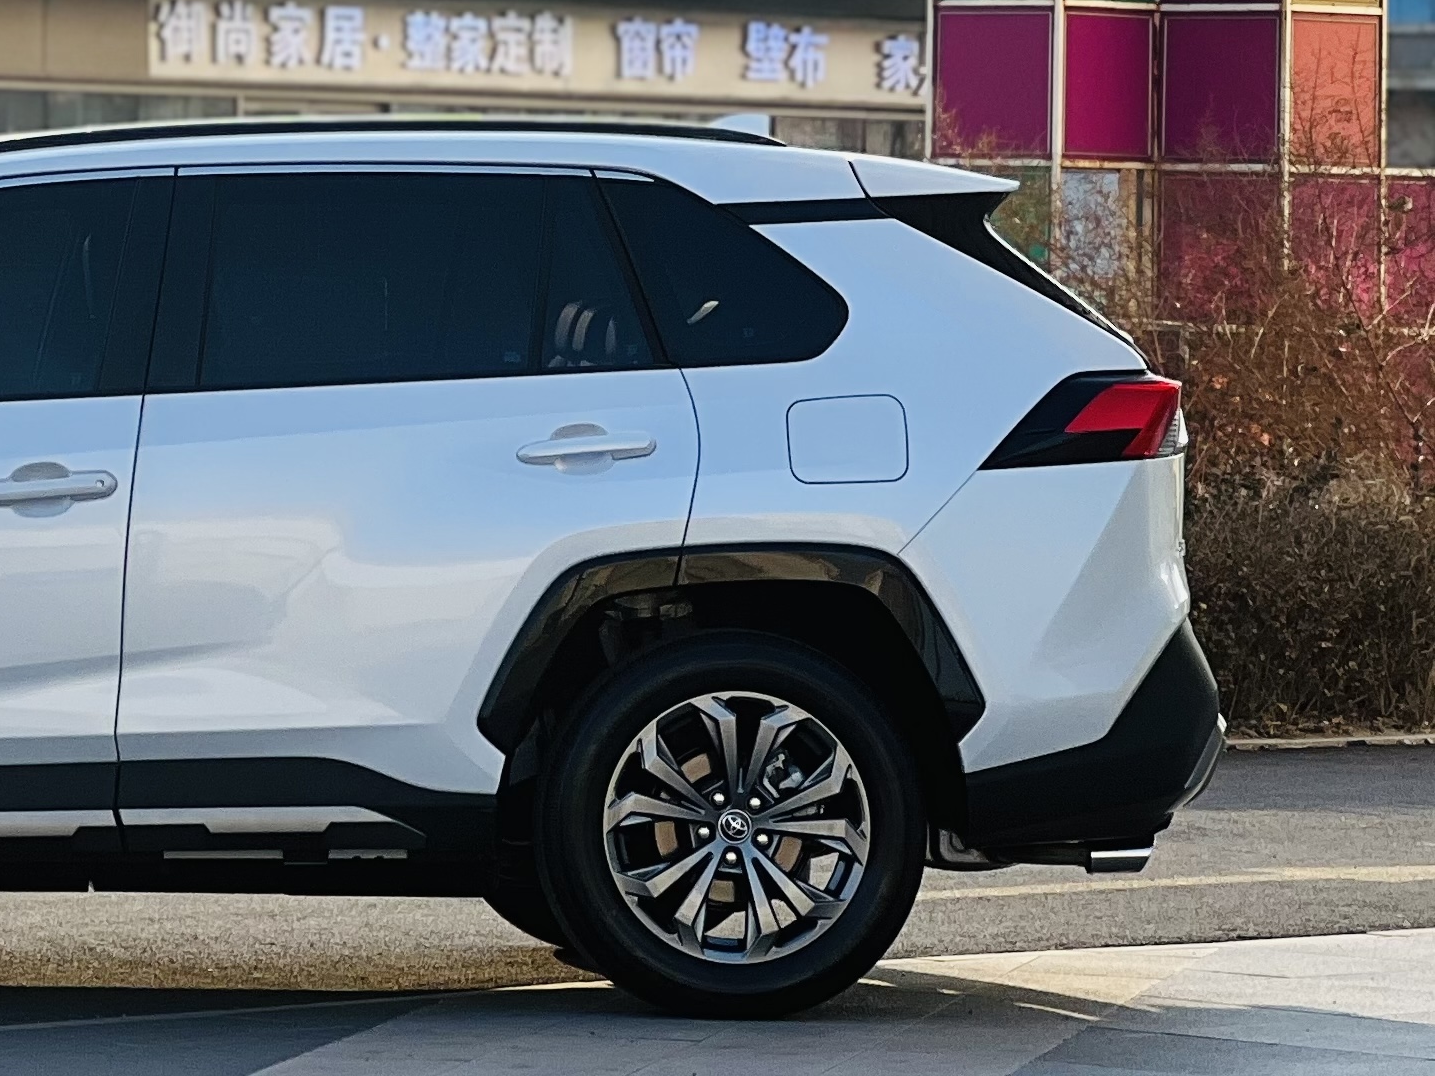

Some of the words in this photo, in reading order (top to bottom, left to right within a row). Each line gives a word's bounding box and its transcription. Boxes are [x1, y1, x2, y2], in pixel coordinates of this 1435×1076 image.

[616, 15, 700, 83] 窗帘
[744, 19, 830, 90] 壁布
[878, 33, 927, 97] 家
